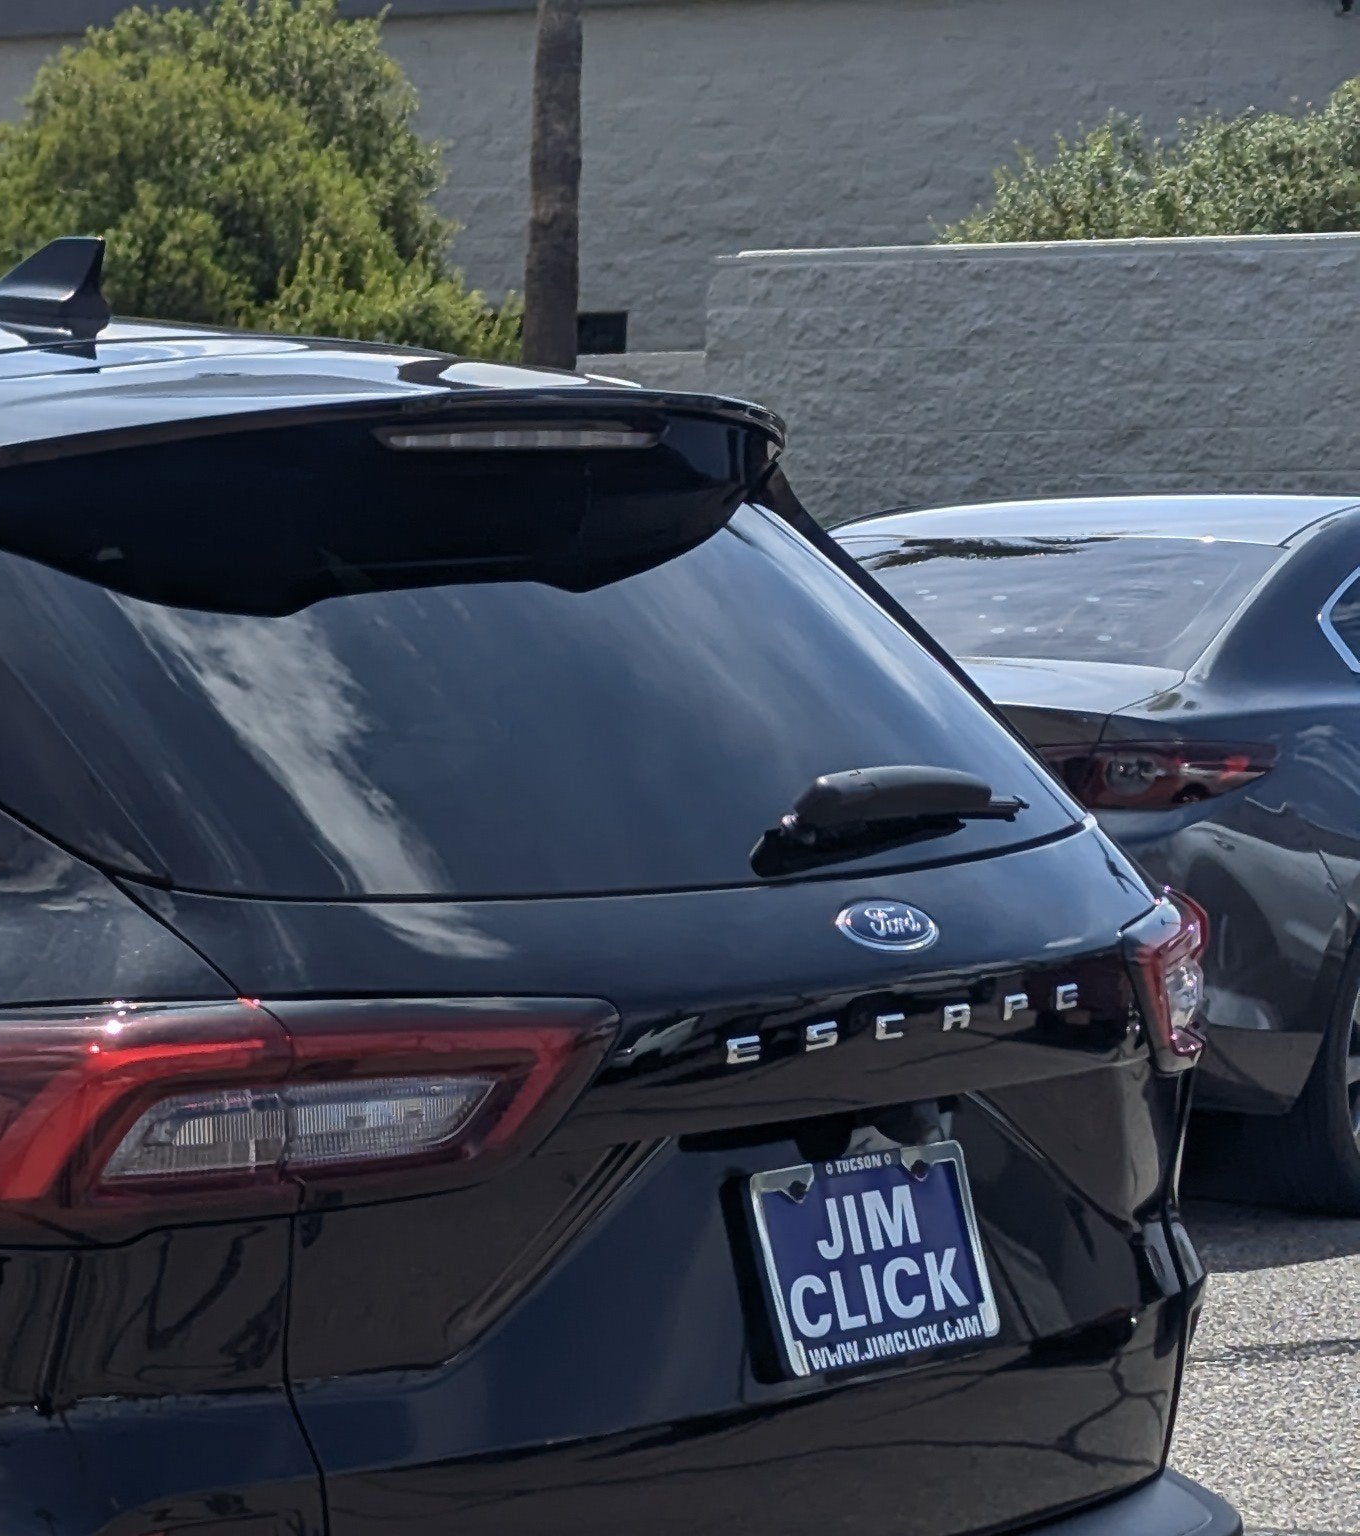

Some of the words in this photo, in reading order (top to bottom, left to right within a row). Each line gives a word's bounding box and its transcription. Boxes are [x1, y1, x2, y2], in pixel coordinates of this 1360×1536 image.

[863, 906, 922, 937] Ford
[725, 983, 1079, 1065] ESCAPE
[836, 1154, 882, 1174] TUCSON
[816, 1184, 922, 1260] JIM
[790, 1247, 970, 1339] CLICK
